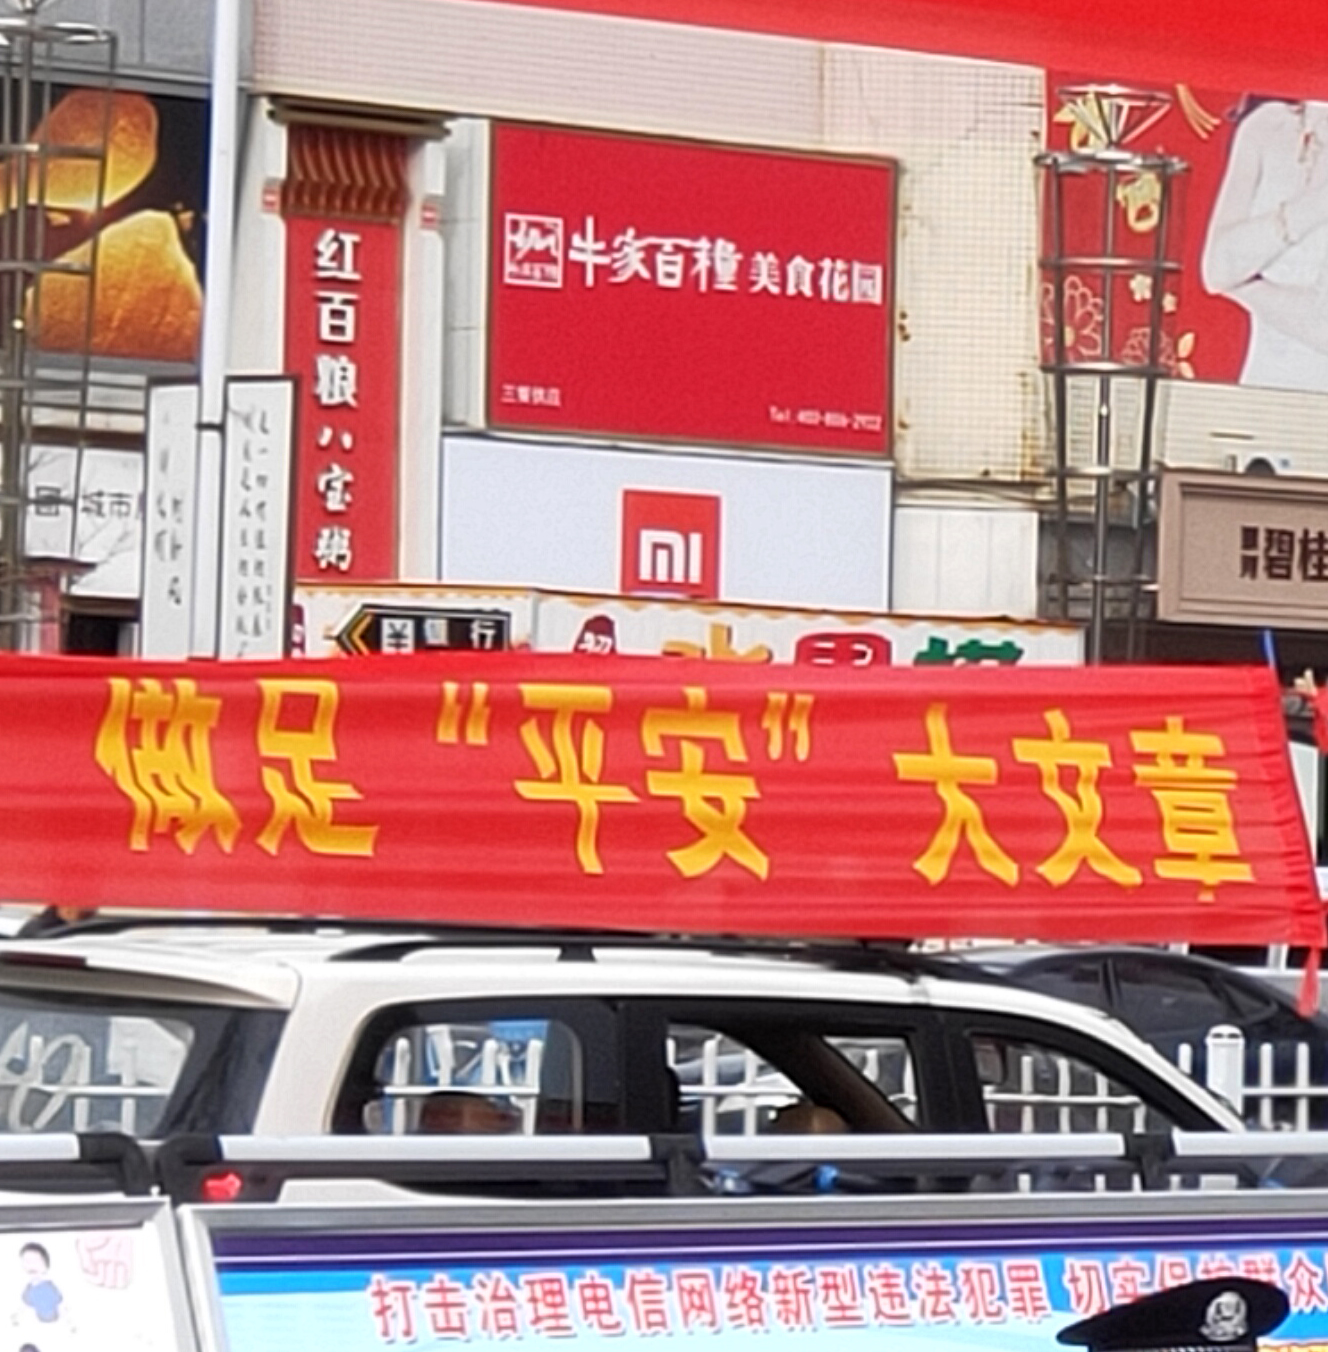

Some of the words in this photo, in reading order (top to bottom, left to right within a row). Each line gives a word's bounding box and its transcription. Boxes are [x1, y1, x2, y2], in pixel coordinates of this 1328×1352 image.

[312, 228, 362, 572] 红百粮八宝粥
[96, 676, 1254, 902] 做足“平安”大文章
[371, 1257, 1050, 1341] 打击治理电信网络新型违法犯罪
